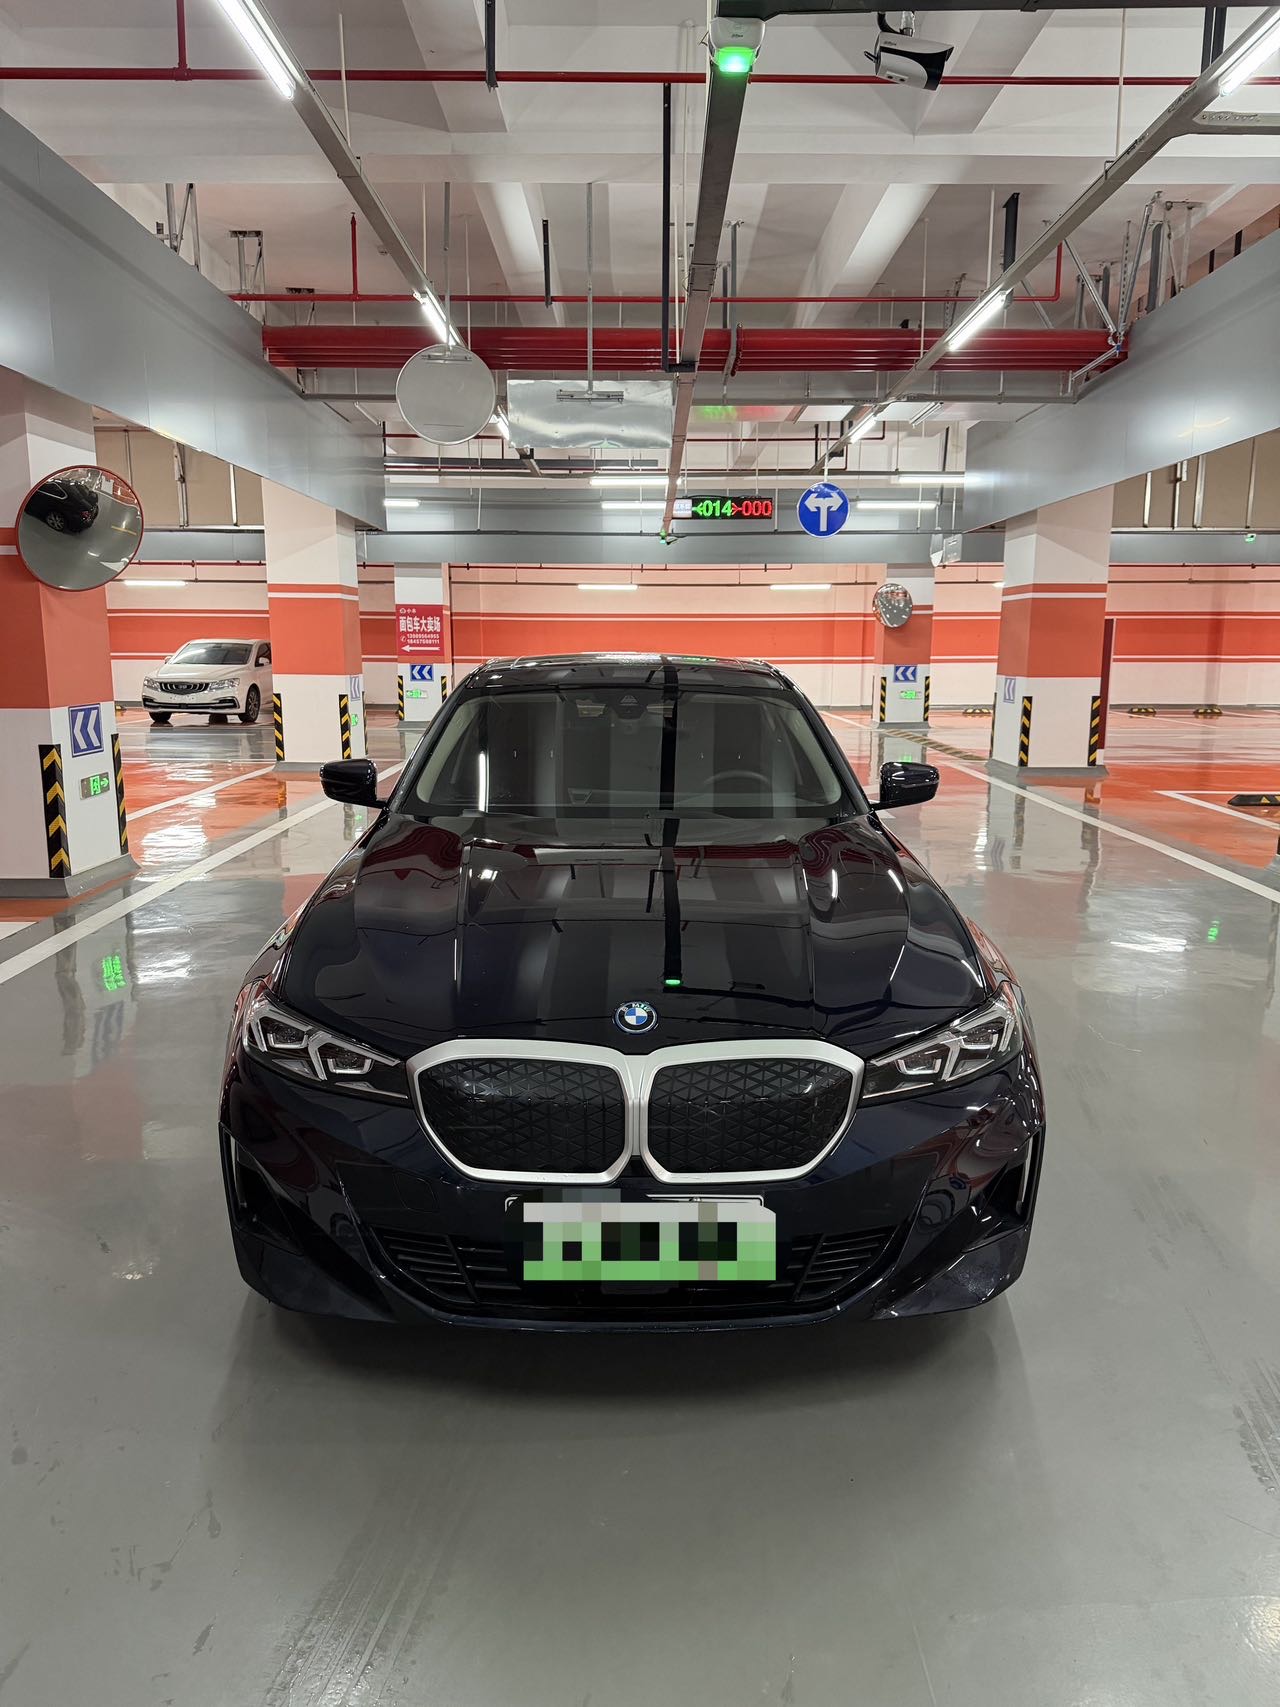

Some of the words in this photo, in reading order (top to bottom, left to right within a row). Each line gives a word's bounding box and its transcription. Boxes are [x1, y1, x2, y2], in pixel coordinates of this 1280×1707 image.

[703, 500, 731, 516] 014
[742, 500, 772, 516] 000
[399, 616, 440, 632] 面包车大卖场
[620, 1003, 650, 1012] BMW
